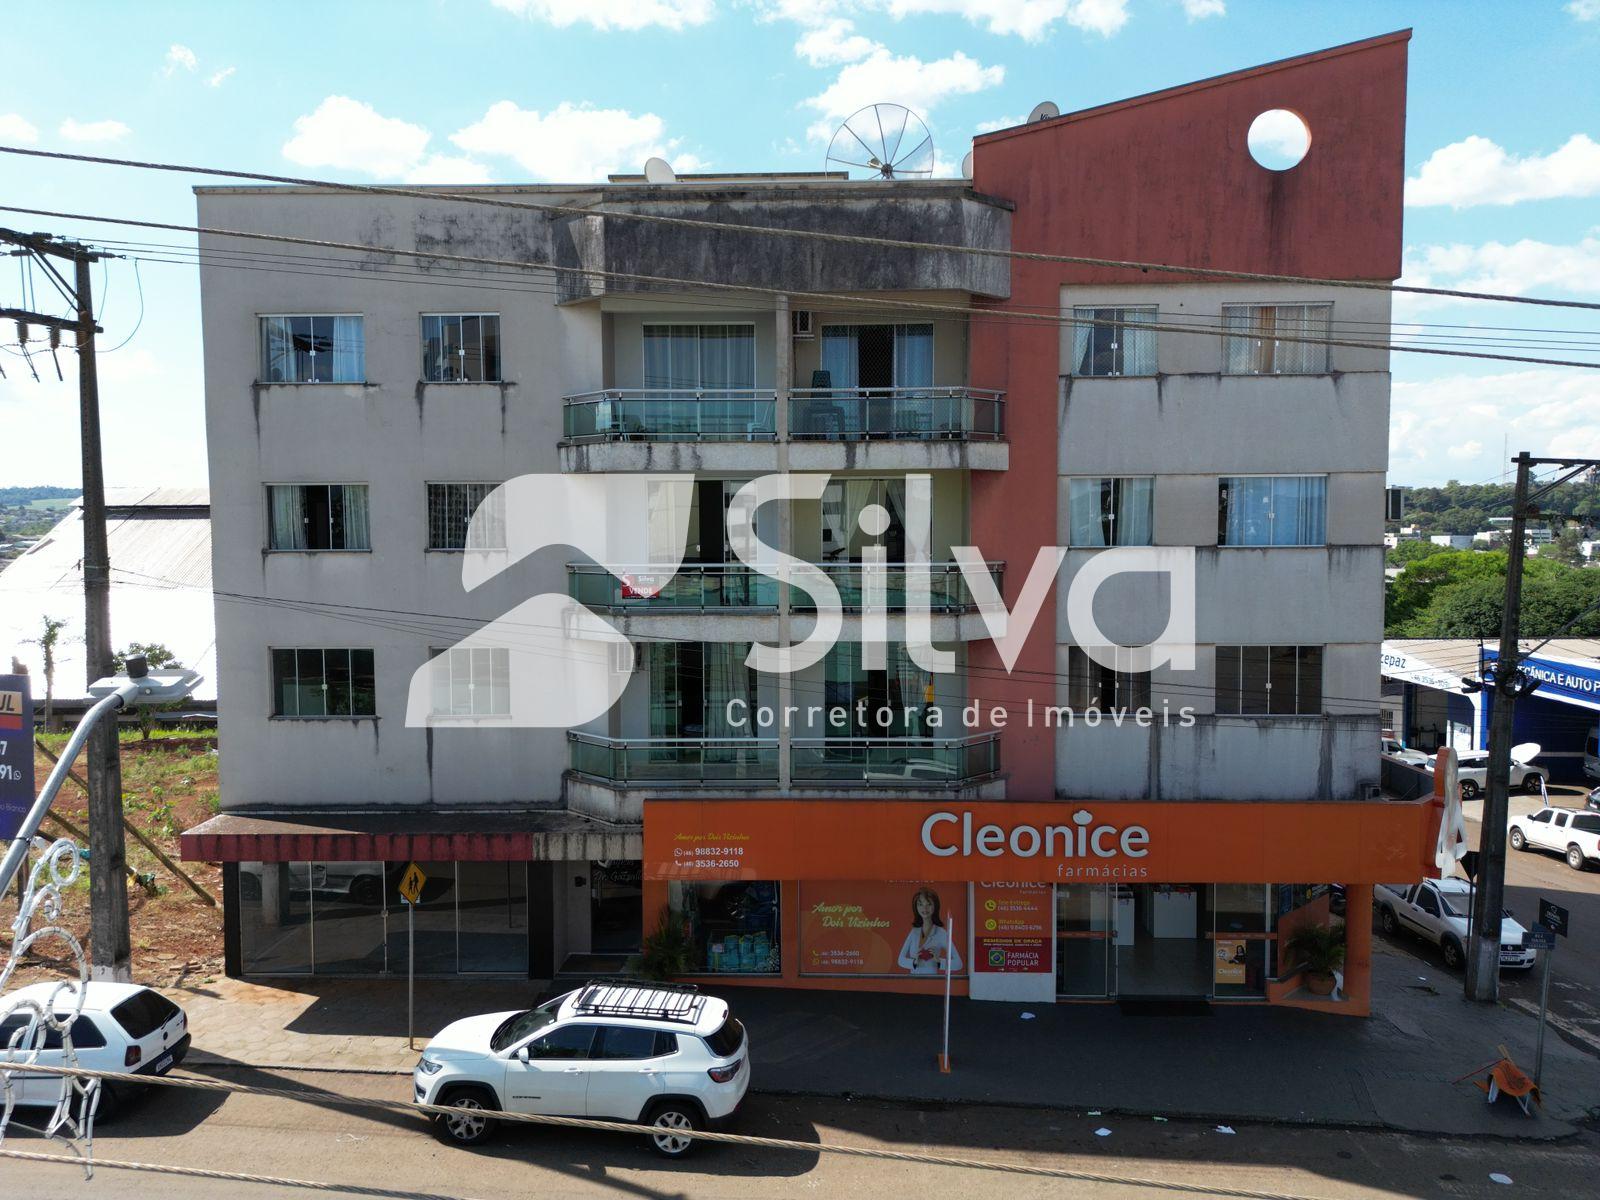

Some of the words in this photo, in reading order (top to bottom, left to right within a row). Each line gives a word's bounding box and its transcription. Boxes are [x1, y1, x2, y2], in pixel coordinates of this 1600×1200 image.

[1557, 674, 1564, 686] E
[1565, 675, 1592, 691] AUTO
[921, 810, 1150, 858] Cleonice
[695, 847, 744, 856] 98832-9118
[695, 859, 740, 868] 3536-2650
[1057, 864, 1148, 879] farmácias
[811, 901, 842, 914] Amor
[842, 903, 863, 917] por
[822, 915, 844, 928] Dois
[847, 916, 891, 928] Vizinhos
[1007, 951, 1039, 959] FARMÁCIA
